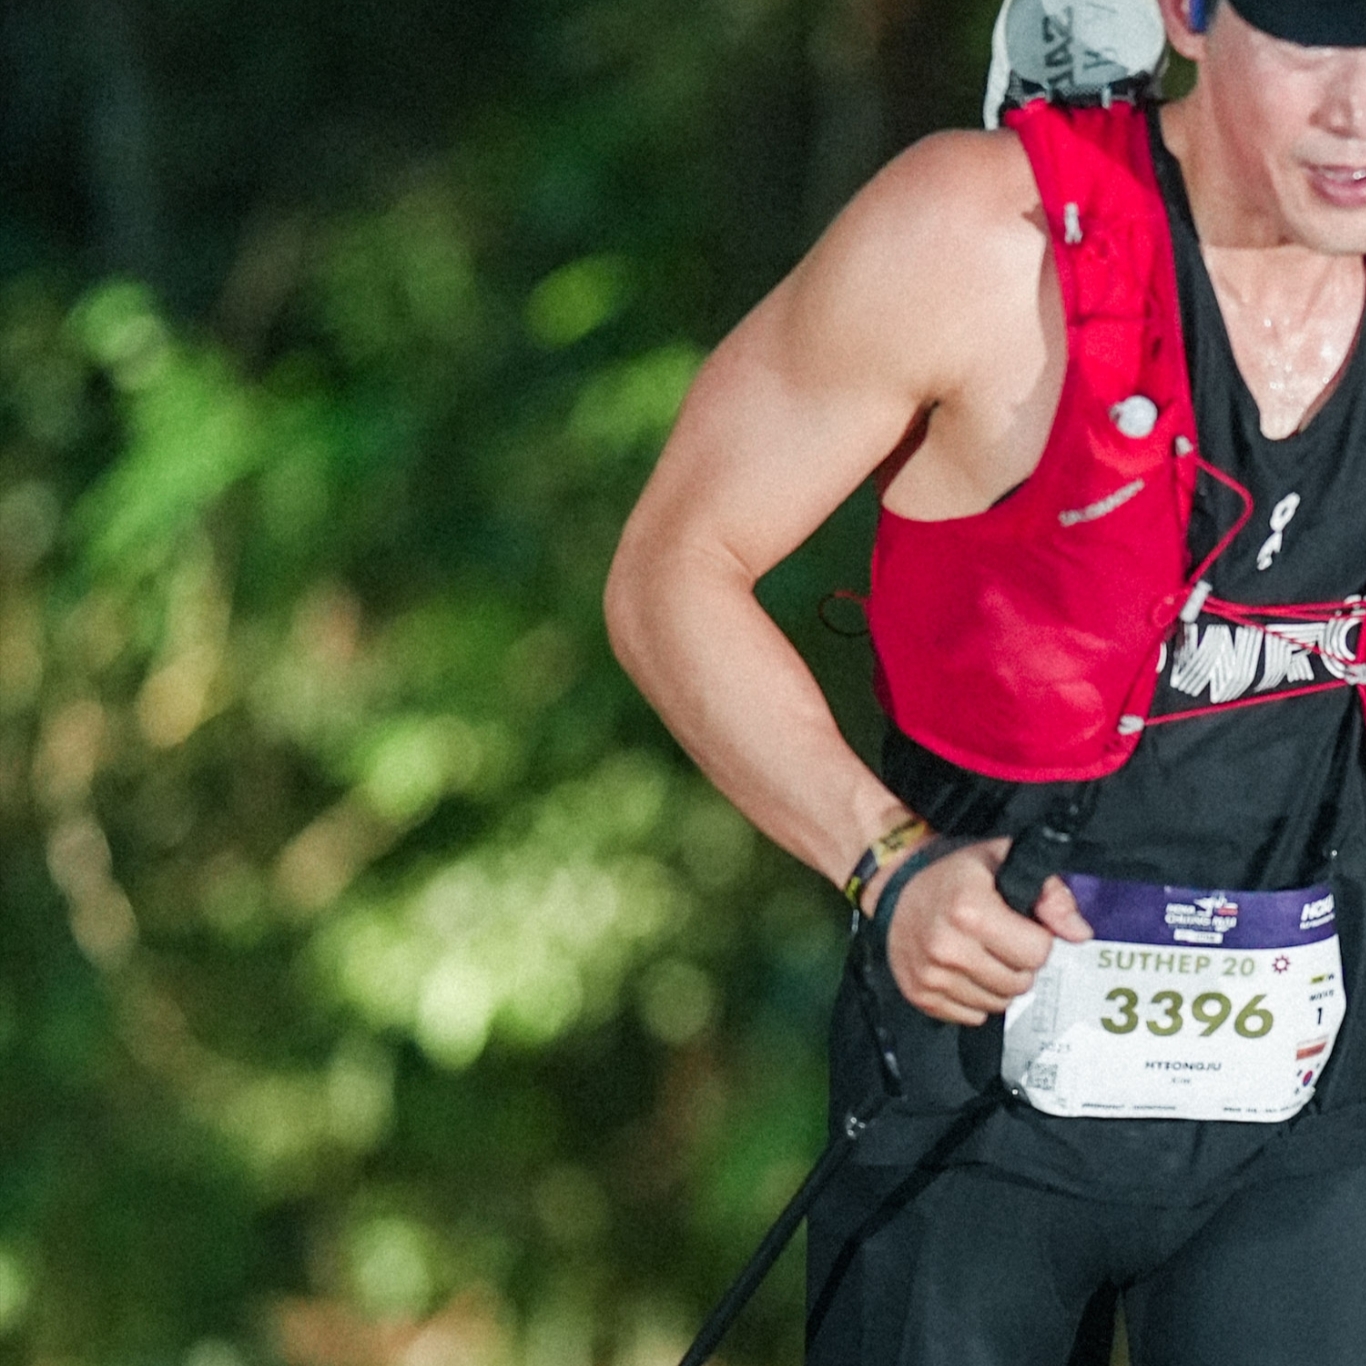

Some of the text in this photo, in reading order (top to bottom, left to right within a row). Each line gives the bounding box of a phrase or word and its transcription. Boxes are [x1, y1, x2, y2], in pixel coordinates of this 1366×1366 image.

[1098, 950, 1255, 976] SUTHEP 20
[1101, 987, 1274, 1039] 3396
